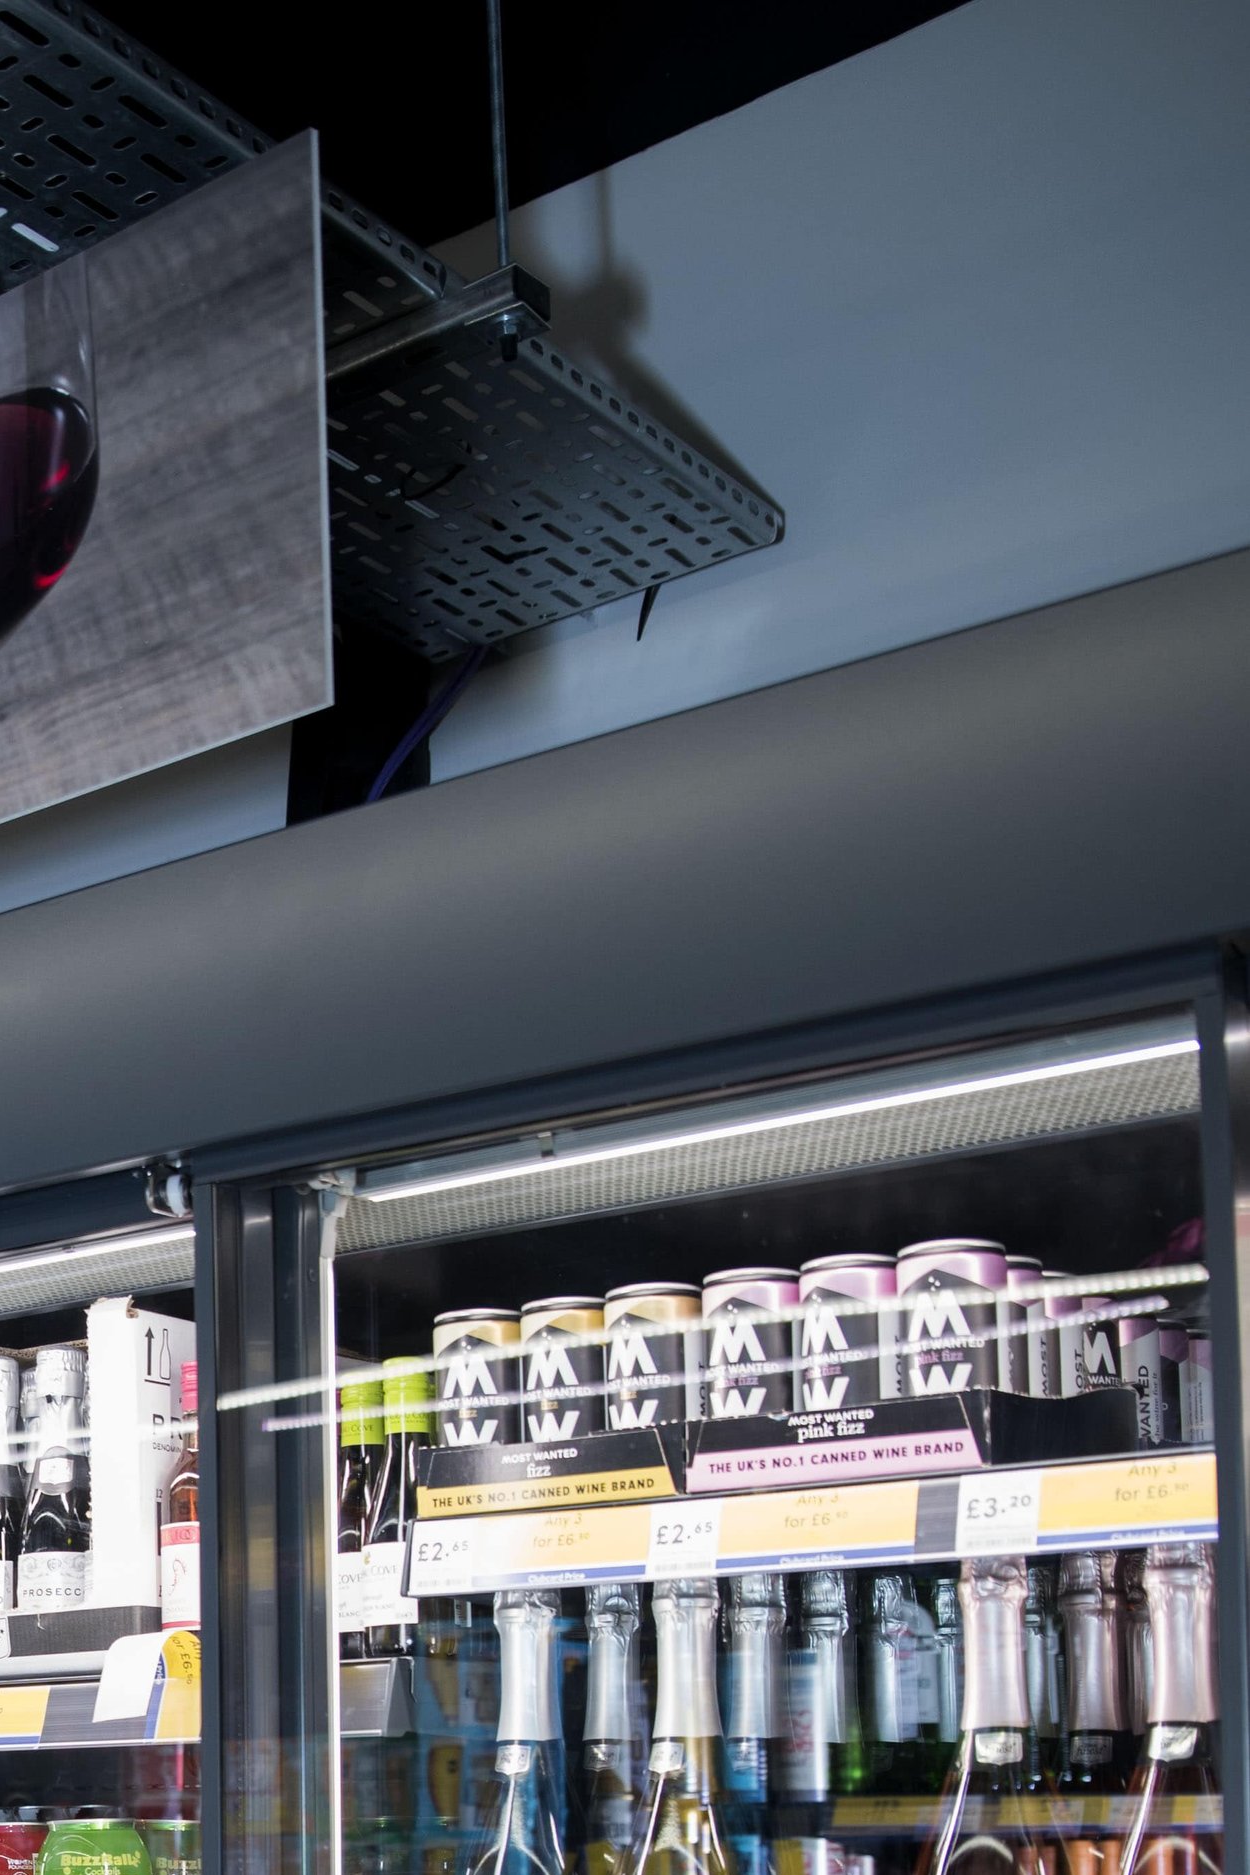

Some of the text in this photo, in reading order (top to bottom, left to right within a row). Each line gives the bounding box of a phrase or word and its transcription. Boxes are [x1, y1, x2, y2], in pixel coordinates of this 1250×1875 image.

[788, 1408, 874, 1426] MOST WANTED
[797, 1421, 865, 1444] pink fizz
[501, 1448, 579, 1464] MOST WANTED
[709, 1441, 965, 1475] THE UK'S NO.1 CANNED WINE BRAND
[526, 1464, 551, 1478] fizz
[432, 1497, 454, 1509] THE
[456, 1494, 484, 1507] UK'S
[521, 1486, 571, 1501] CANNED
[576, 1483, 609, 1496] WINE
[612, 1478, 655, 1492] BRAND
[966, 1494, 1032, 1519] £3.20
[656, 1522, 713, 1546] £2.65
[417, 1539, 469, 1563] £2.65
